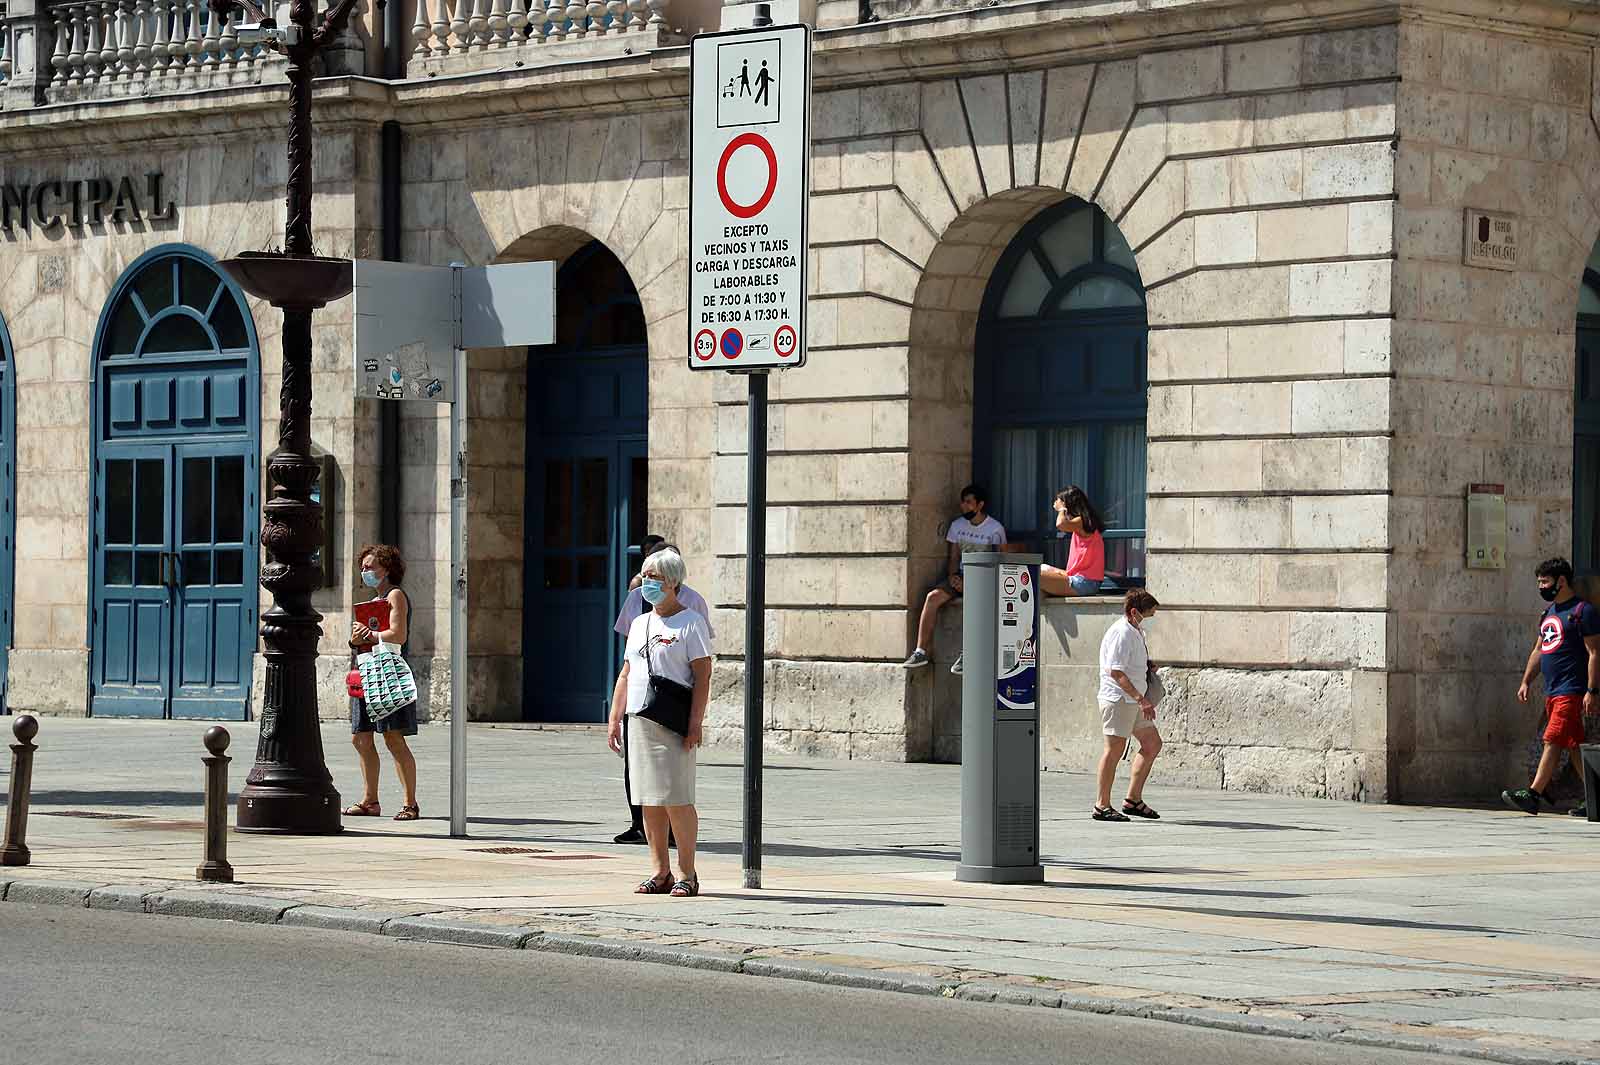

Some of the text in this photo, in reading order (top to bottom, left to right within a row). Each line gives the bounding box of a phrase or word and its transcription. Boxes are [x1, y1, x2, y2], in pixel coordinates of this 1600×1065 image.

[723, 223, 769, 238] EXCEPTO
[704, 239, 789, 255] VECINOS Y TAXIS
[695, 256, 797, 273] CARGA Y DESCARGA
[714, 274, 779, 289] LABORABLES
[703, 292, 786, 306] DE 7:00 A 11:30 Y
[702, 308, 790, 323] DE 16:30 A 17:30 H.
[779, 335, 792, 346] 20
